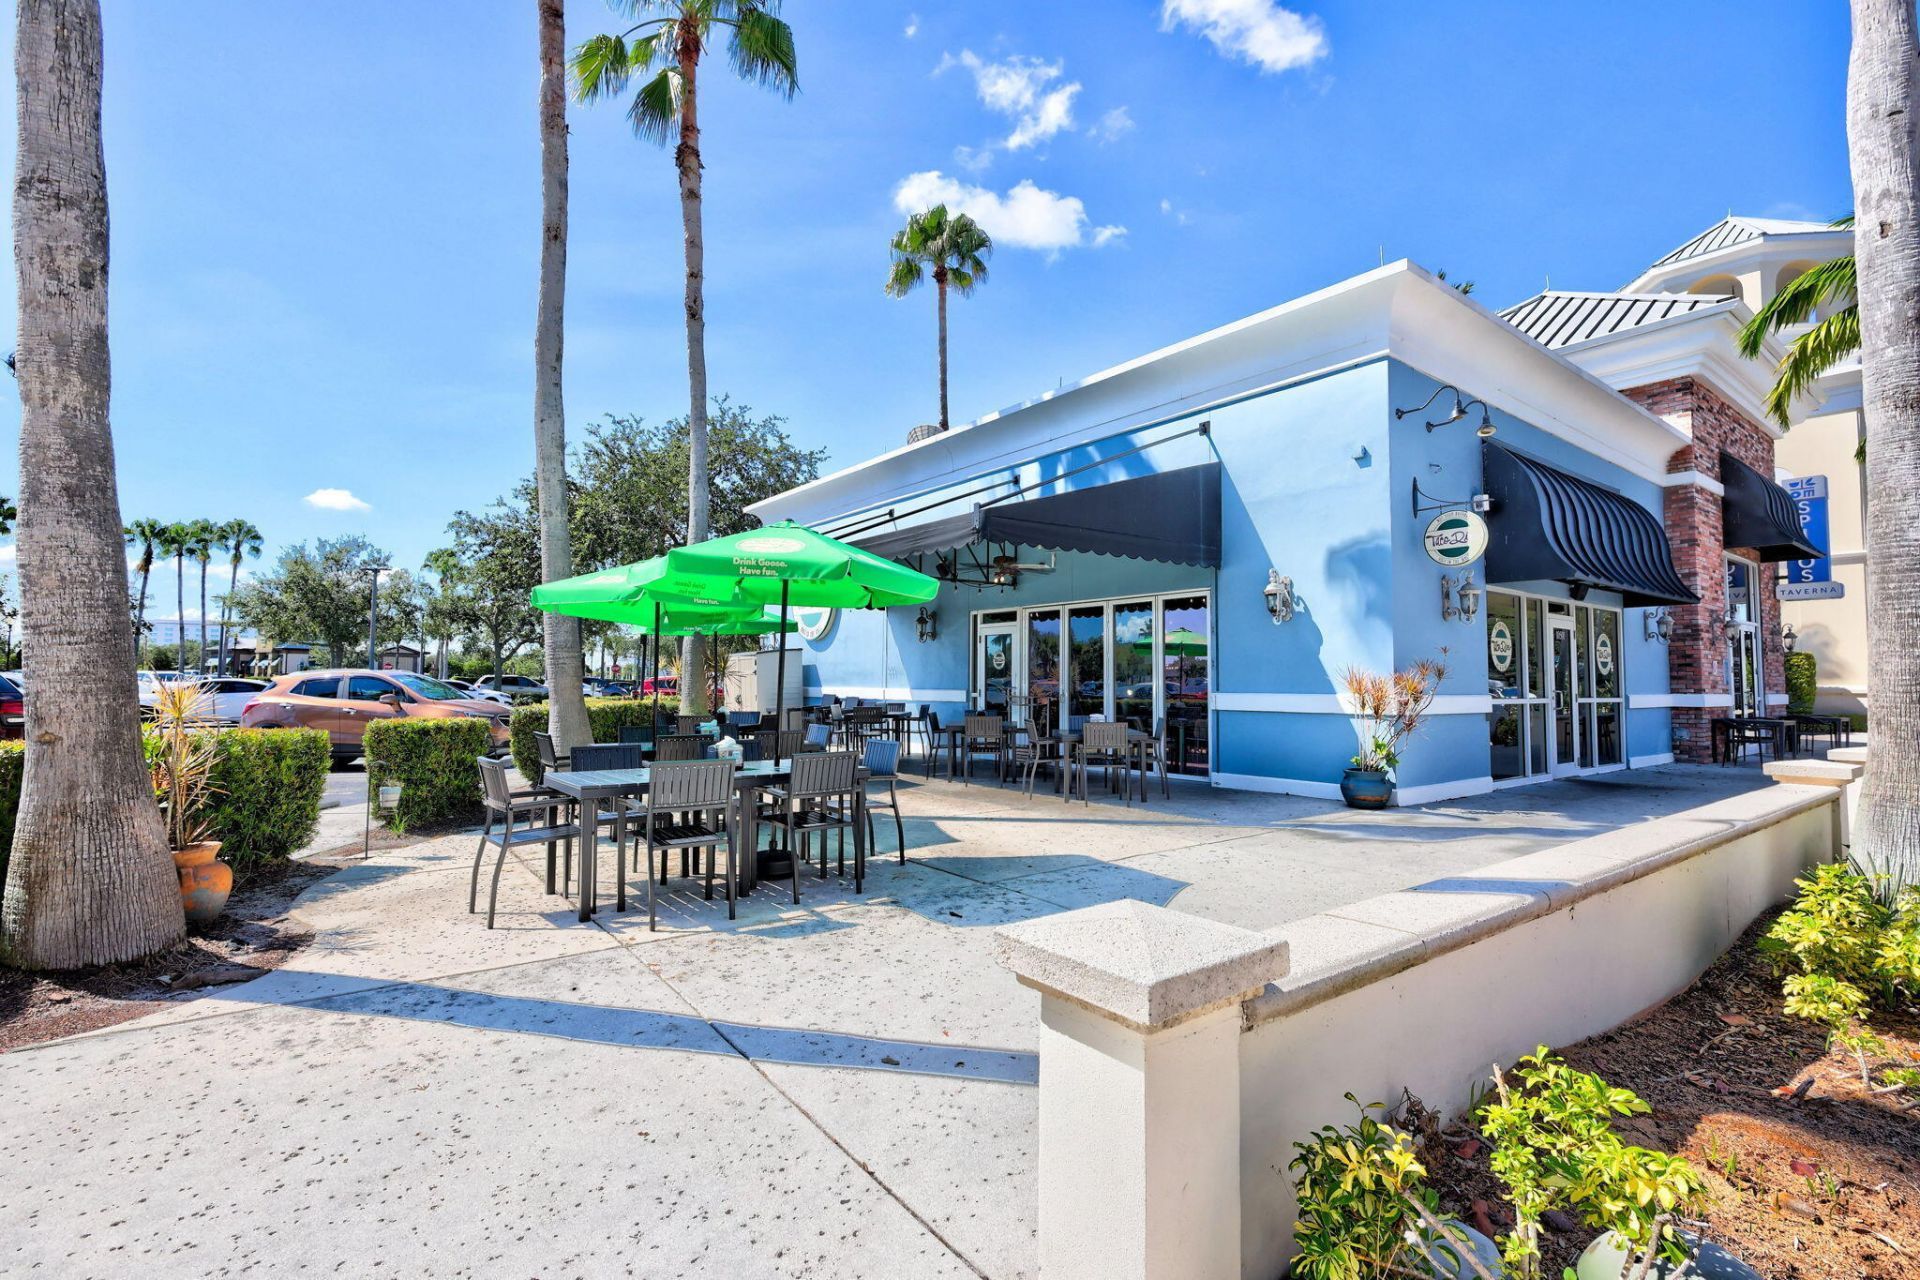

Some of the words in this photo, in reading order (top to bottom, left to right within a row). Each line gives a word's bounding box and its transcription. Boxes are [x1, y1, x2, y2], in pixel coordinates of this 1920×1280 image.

[732, 556, 757, 566] Drink
[758, 558, 788, 567] Goose.
[739, 567, 761, 575] Have
[762, 567, 778, 576] fun.
[1780, 586, 1838, 596] TAVERNA
